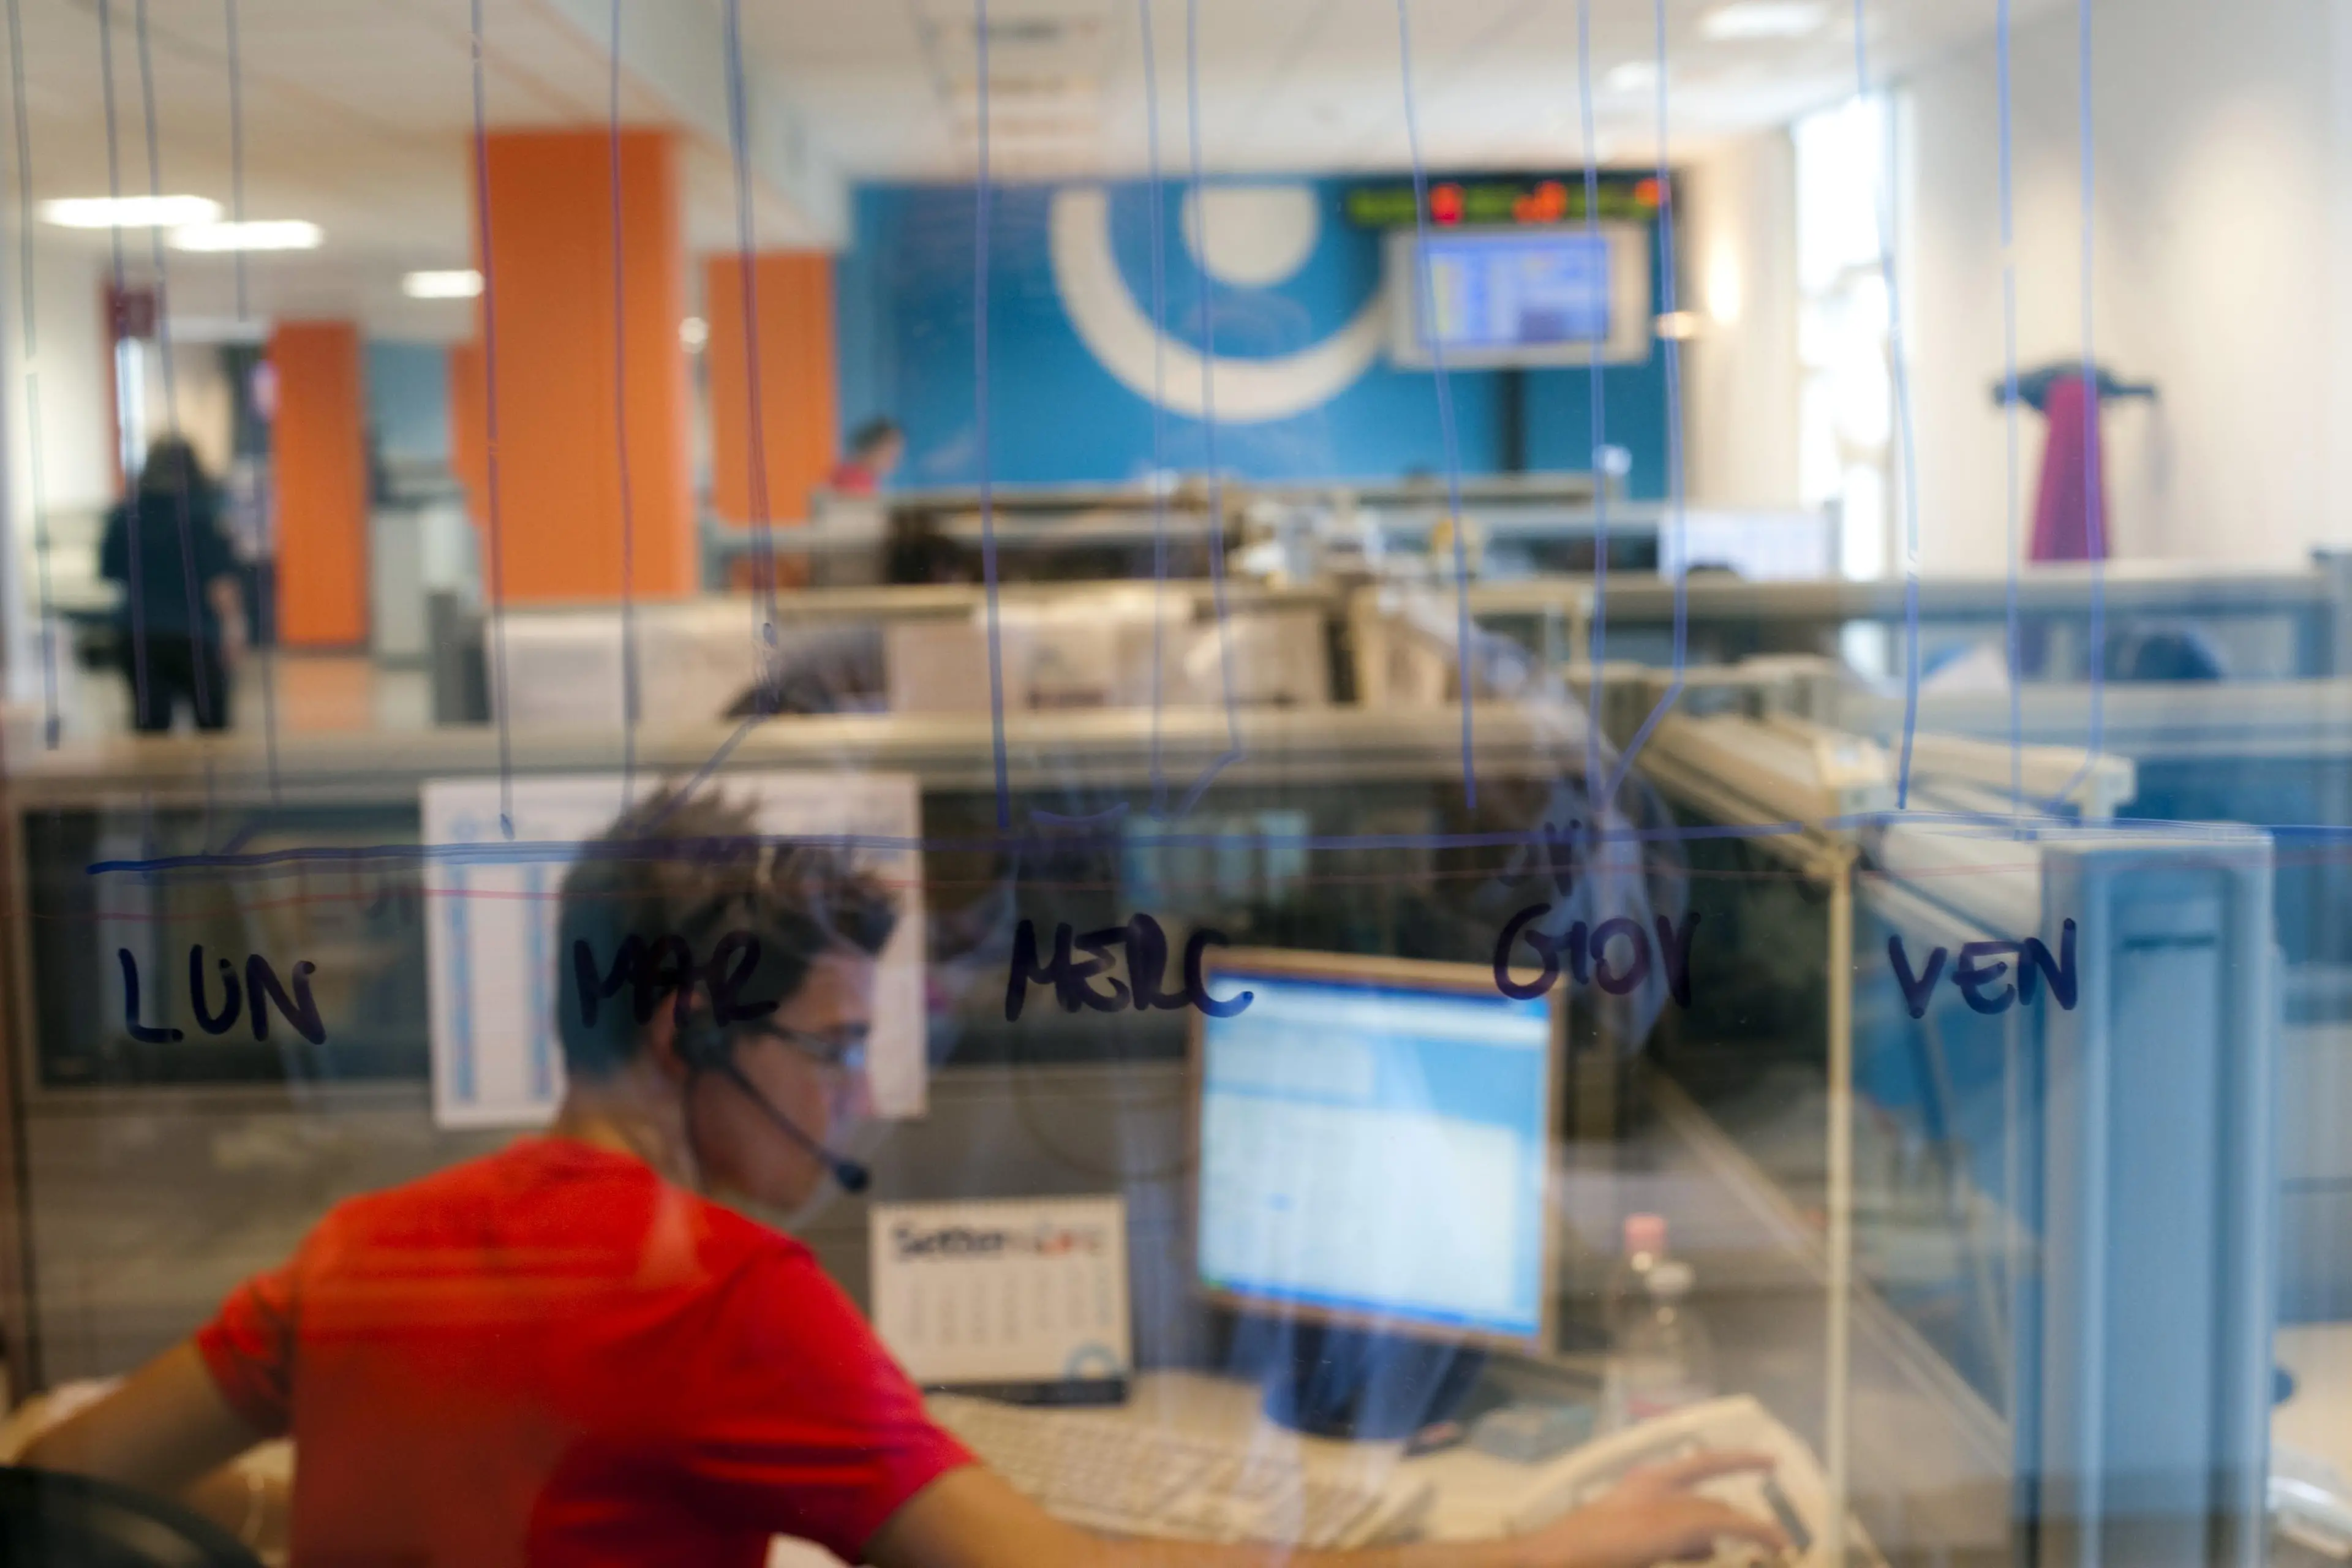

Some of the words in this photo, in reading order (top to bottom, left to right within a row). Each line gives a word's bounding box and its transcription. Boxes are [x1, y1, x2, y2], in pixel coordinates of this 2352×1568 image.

[118, 944, 327, 1045] LUN
[573, 930, 780, 1028] MAR
[1005, 913, 1254, 1022] MERC
[1493, 903, 1702, 1009] GIOV
[1888, 918, 2078, 1019] VEN
